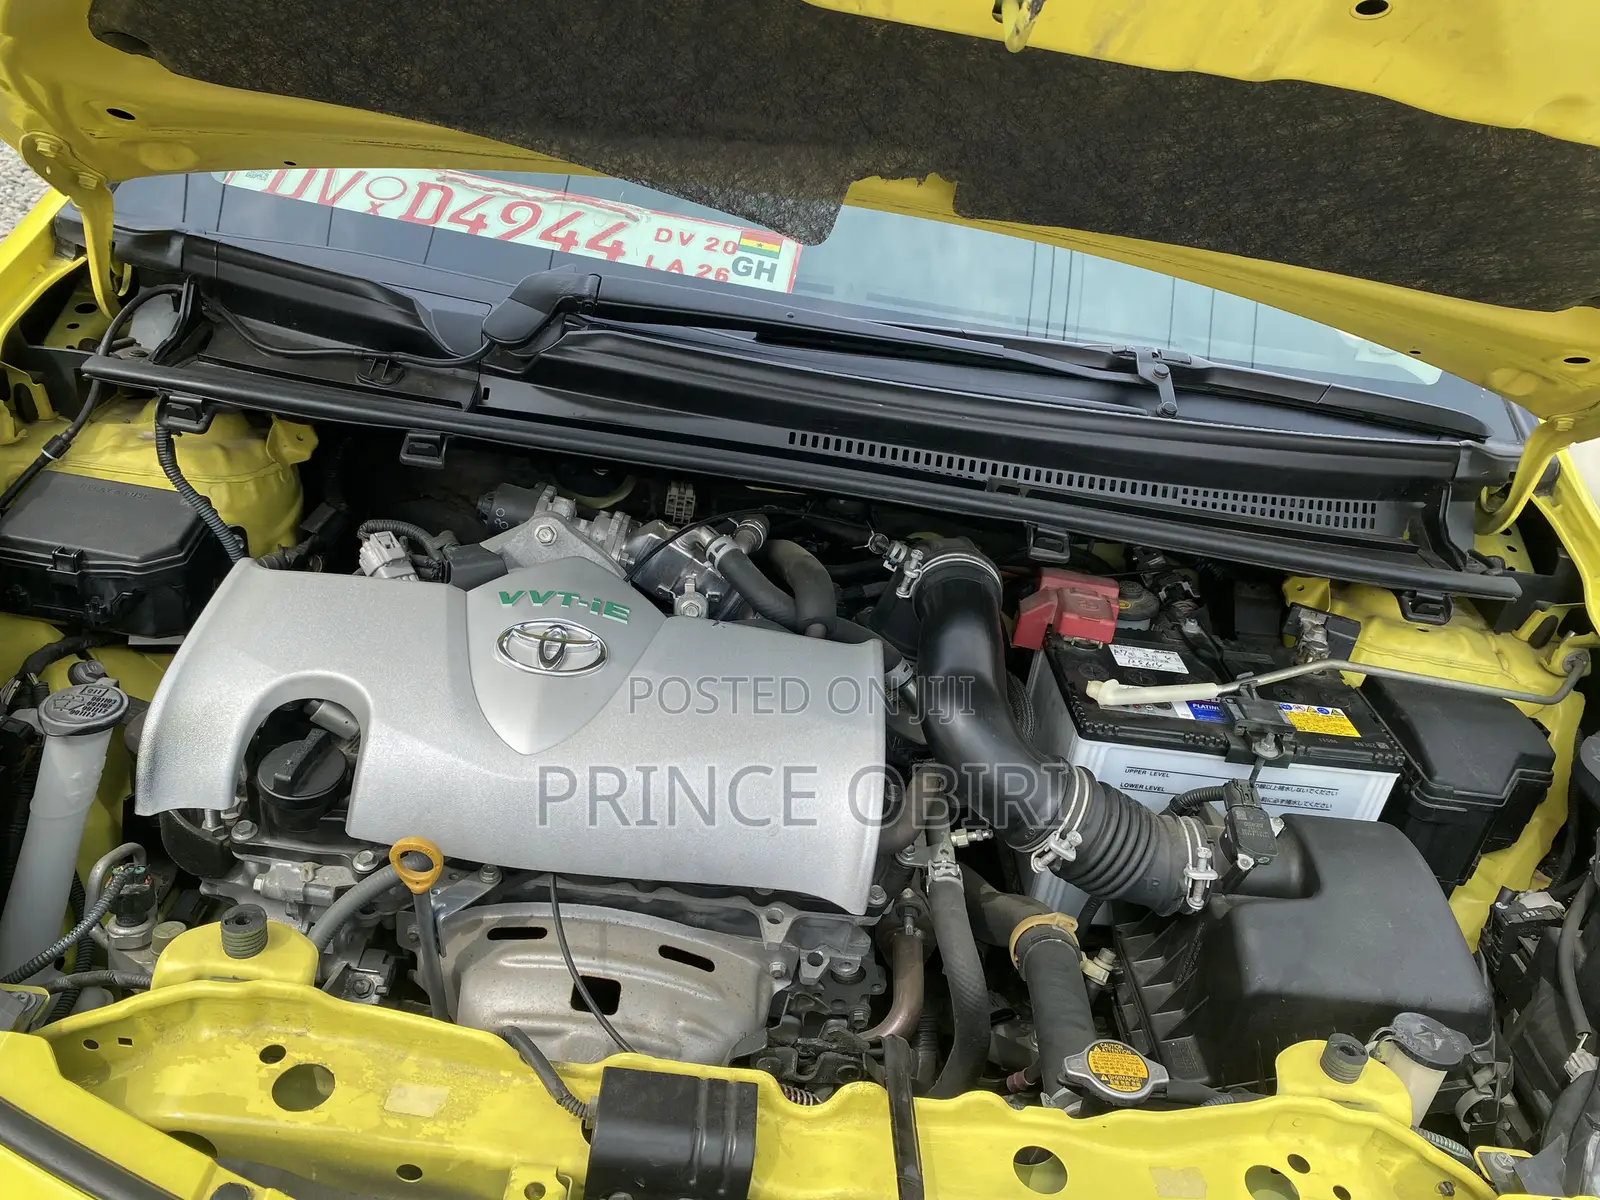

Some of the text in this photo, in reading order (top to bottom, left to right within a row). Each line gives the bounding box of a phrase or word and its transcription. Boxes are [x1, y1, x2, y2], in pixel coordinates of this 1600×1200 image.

[398, 181, 629, 261] D4944
[654, 228, 739, 256] DV 20
[645, 255, 731, 283] LA 26
[731, 256, 778, 283] GH
[498, 589, 631, 625] VVT-iE
